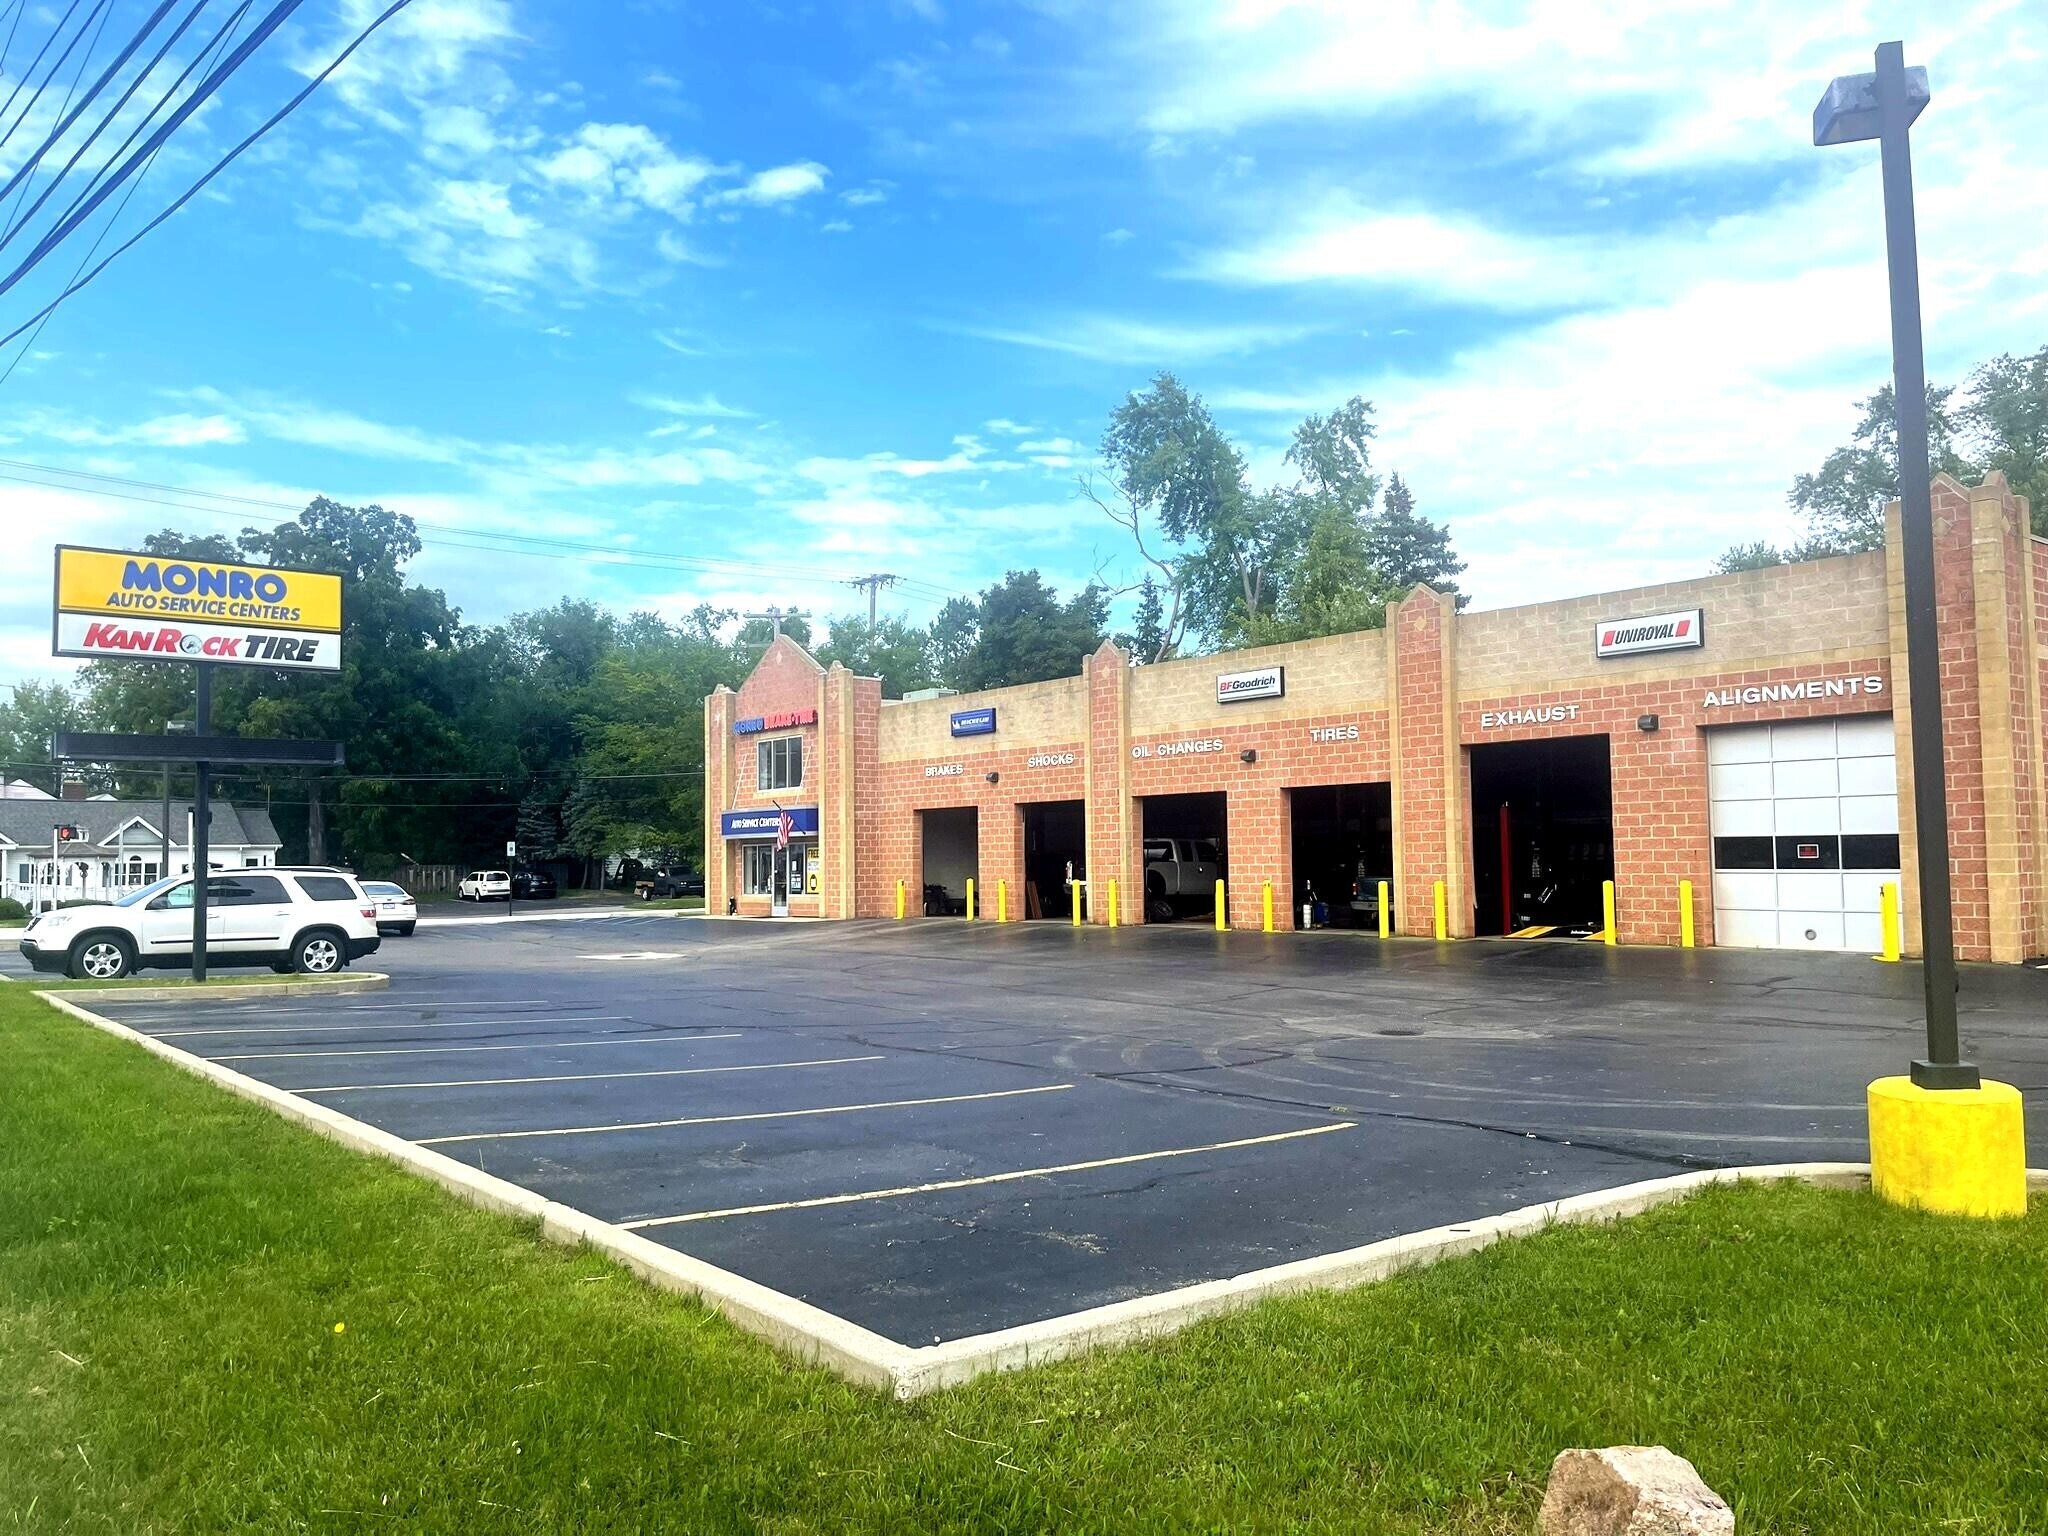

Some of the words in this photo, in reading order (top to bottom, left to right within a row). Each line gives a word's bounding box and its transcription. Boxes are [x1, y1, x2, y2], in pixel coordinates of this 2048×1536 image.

[121, 560, 287, 603] MONRO
[106, 592, 158, 609] AUTO
[158, 596, 227, 615] SERVICE
[228, 602, 301, 621] CENTERS
[1614, 623, 1675, 644] UNIROYAL
[244, 635, 320, 662] TIRE
[1219, 675, 1276, 691] BFGoodrich
[1703, 676, 1883, 707] ALIGNMENTS
[1481, 705, 1580, 727] EXHAUST
[1310, 725, 1359, 742] TIRES
[1132, 745, 1152, 759] OIL
[1157, 738, 1224, 756] CHANGES
[924, 764, 964, 777] BRAKES
[1027, 753, 1075, 768] SHOCKS
